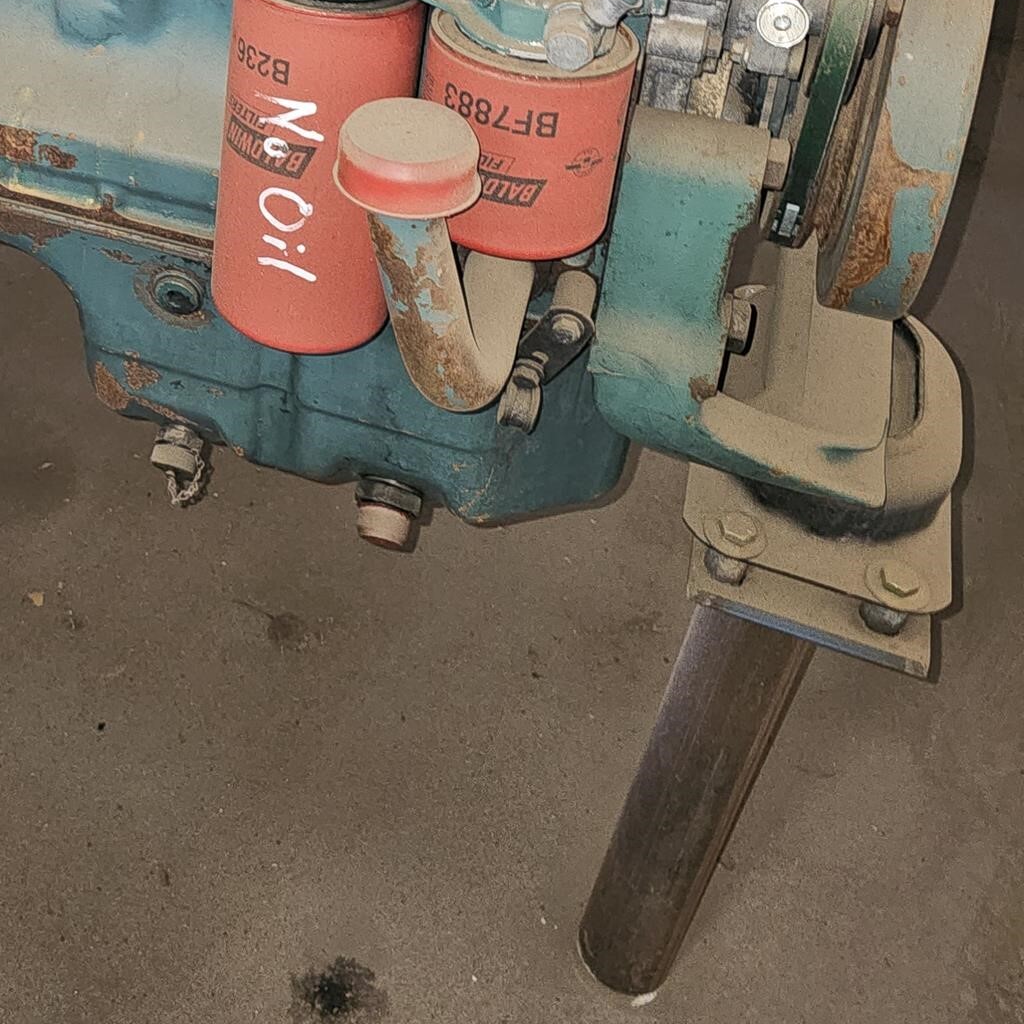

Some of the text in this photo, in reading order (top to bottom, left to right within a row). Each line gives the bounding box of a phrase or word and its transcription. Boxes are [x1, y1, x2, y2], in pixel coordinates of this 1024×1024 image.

[237, 37, 290, 85] B236
[444, 81, 559, 138] BF7883
[257, 187, 317, 282] Oil
